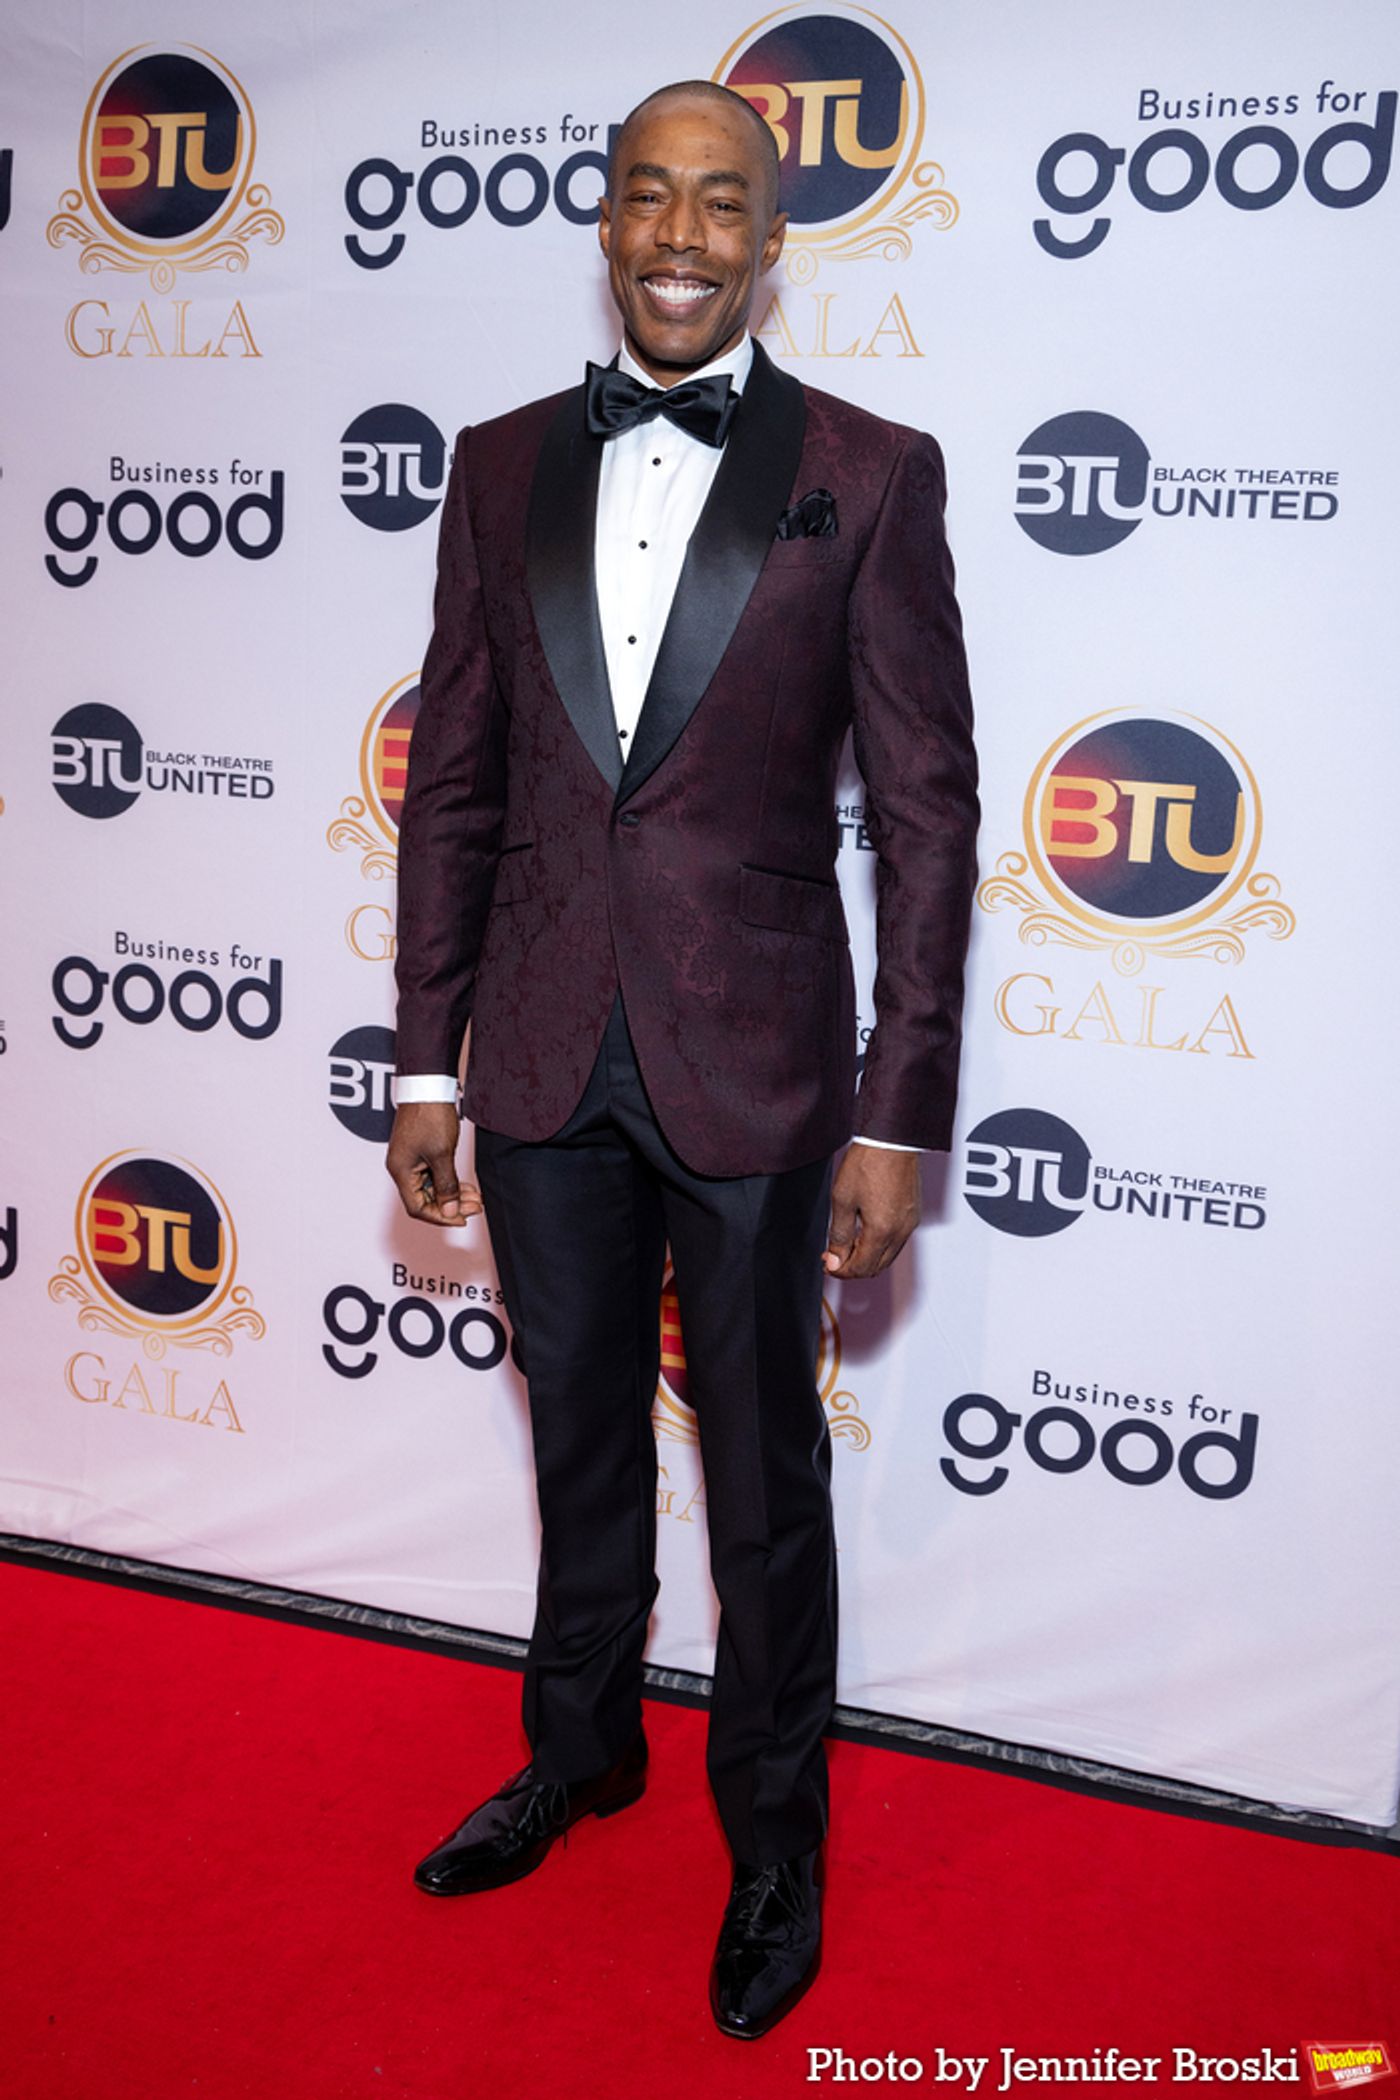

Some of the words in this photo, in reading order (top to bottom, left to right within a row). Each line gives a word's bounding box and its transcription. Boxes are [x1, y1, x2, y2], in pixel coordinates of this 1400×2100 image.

[1138, 89, 1300, 121] Business
[1316, 80, 1367, 113] for
[98, 111, 241, 191] BTU
[420, 120, 547, 148] Business
[560, 114, 599, 142] for
[1033, 90, 1399, 259] good
[64, 299, 263, 358] GALA
[752, 292, 925, 357] ALA
[110, 457, 218, 485] Business
[229, 460, 263, 485] for
[340, 442, 448, 500] BTU
[1014, 454, 1152, 520] BTU
[1153, 467, 1227, 483] BLACK
[1234, 468, 1339, 486] THEATRE
[45, 470, 284, 588] good
[1151, 487, 1339, 520] UNITED
[51, 735, 143, 793] BTU
[146, 751, 196, 767] BLACK
[202, 755, 273, 771] THEATRE
[146, 767, 274, 799] UNITED
[1047, 775, 1243, 873] BTU
[115, 932, 219, 966] Business
[230, 945, 262, 970] for
[52, 956, 282, 1050] good
[994, 972, 1256, 1059] GALA
[328, 1056, 396, 1112] BT
[963, 1142, 1092, 1211] BTU
[1094, 1166, 1163, 1188] BLACK
[1170, 1175, 1267, 1200] THEATRE
[1093, 1185, 1266, 1230] UNITED
[90, 1198, 223, 1284] BTU
[392, 1263, 504, 1305] Business
[322, 1285, 528, 1380] goo
[64, 1351, 246, 1433] GALA
[1032, 1370, 1173, 1416] Business
[1189, 1394, 1231, 1424] for
[940, 1393, 1259, 1500] good
